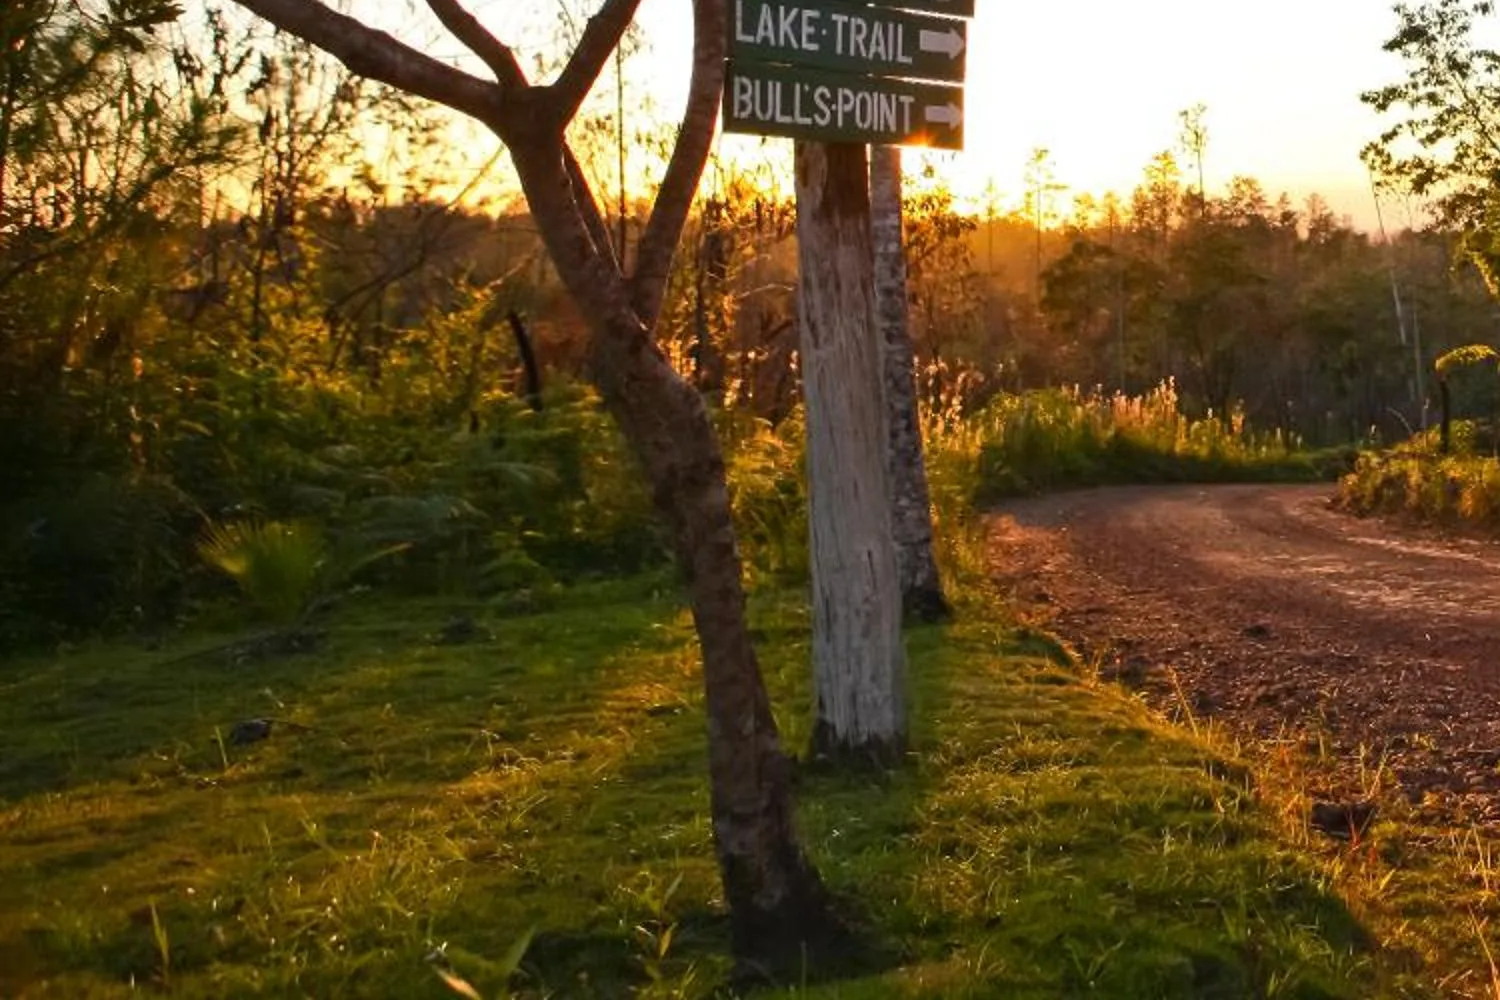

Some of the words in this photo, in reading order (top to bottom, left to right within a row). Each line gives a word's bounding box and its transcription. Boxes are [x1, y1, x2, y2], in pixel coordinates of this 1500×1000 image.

[735, 0, 820, 52] LAKE
[831, 13, 913, 65] TRAIL
[732, 75, 831, 127] BULL'S
[837, 87, 915, 134] POINT
